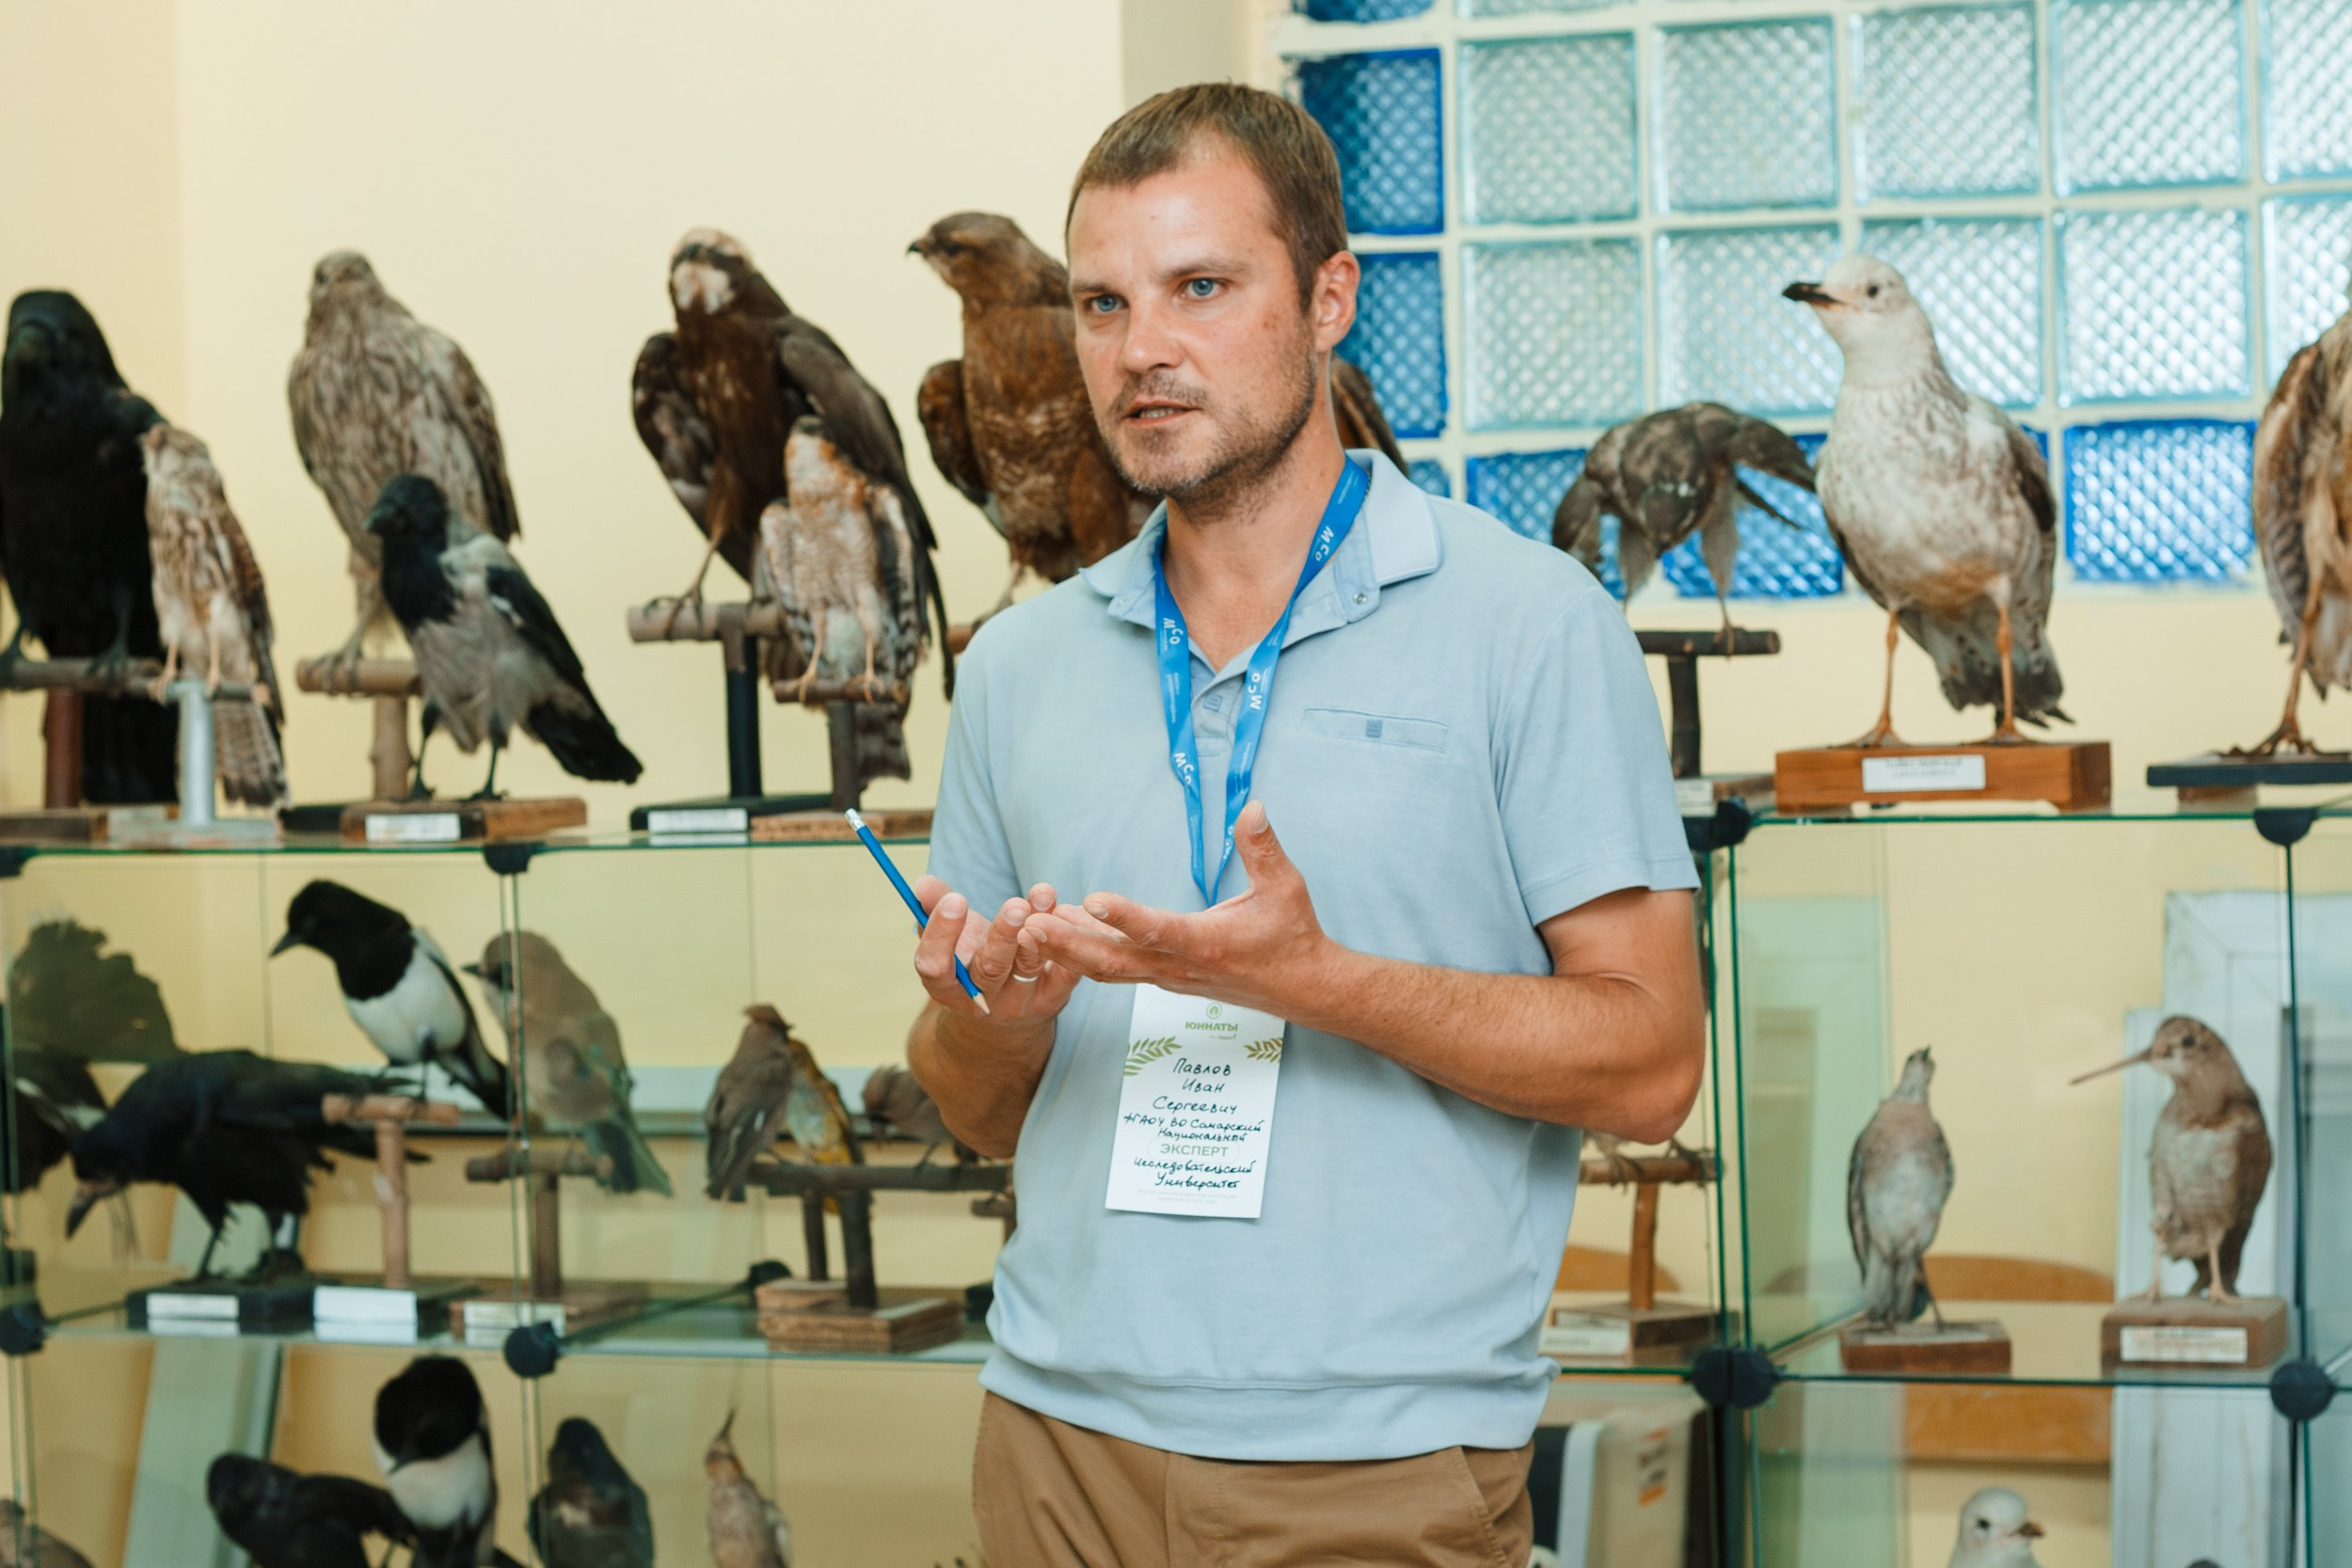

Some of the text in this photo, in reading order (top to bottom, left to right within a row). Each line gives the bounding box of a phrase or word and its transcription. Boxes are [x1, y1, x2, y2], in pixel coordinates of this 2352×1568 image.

[1184, 1021, 1239, 1032] ЮННАТЫ
[1172, 1056, 1232, 1076] Павлов
[1182, 1077, 1227, 1094] Иван
[1152, 1095, 1238, 1116] Сергеевич
[1169, 1117, 1187, 1128] ВО
[1190, 1118, 1265, 1133] Самарский
[1159, 1143, 1230, 1157] ЭКСПЕРТ
